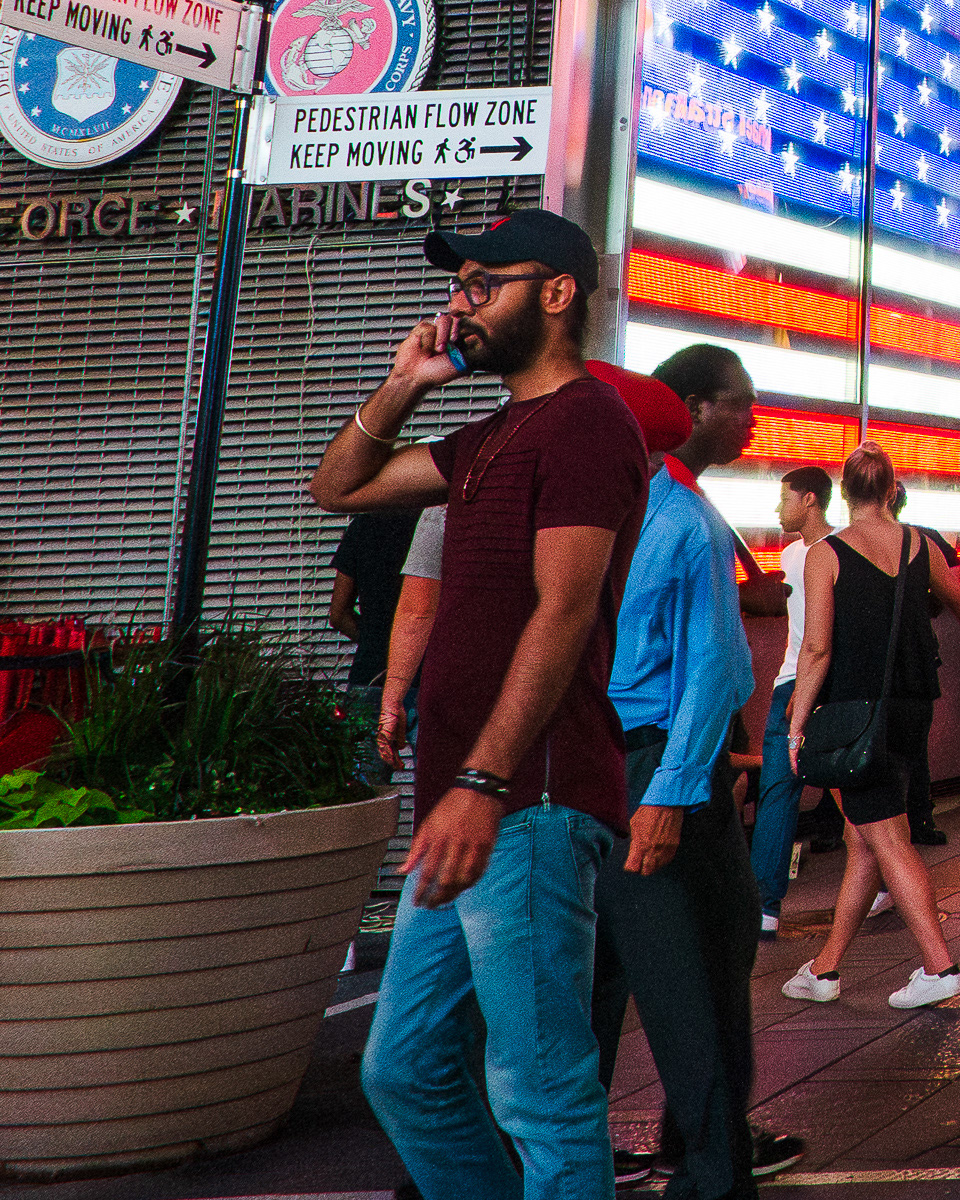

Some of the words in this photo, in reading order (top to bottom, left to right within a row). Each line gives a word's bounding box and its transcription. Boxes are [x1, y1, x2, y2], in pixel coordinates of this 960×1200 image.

[65, 0, 132, 45] MOVING
[385, 45, 412, 91] CORPS
[7, 113, 36, 145] UNITED
[41, 143, 79, 157] STATES
[88, 145, 103, 154] OF
[111, 110, 155, 146] AMERICA
[294, 104, 417, 133] PEDESTRIAN
[424, 102, 478, 128] FLOW
[485, 100, 537, 126] ZONE
[290, 142, 339, 169] KEEP
[346, 140, 423, 167] MOVING
